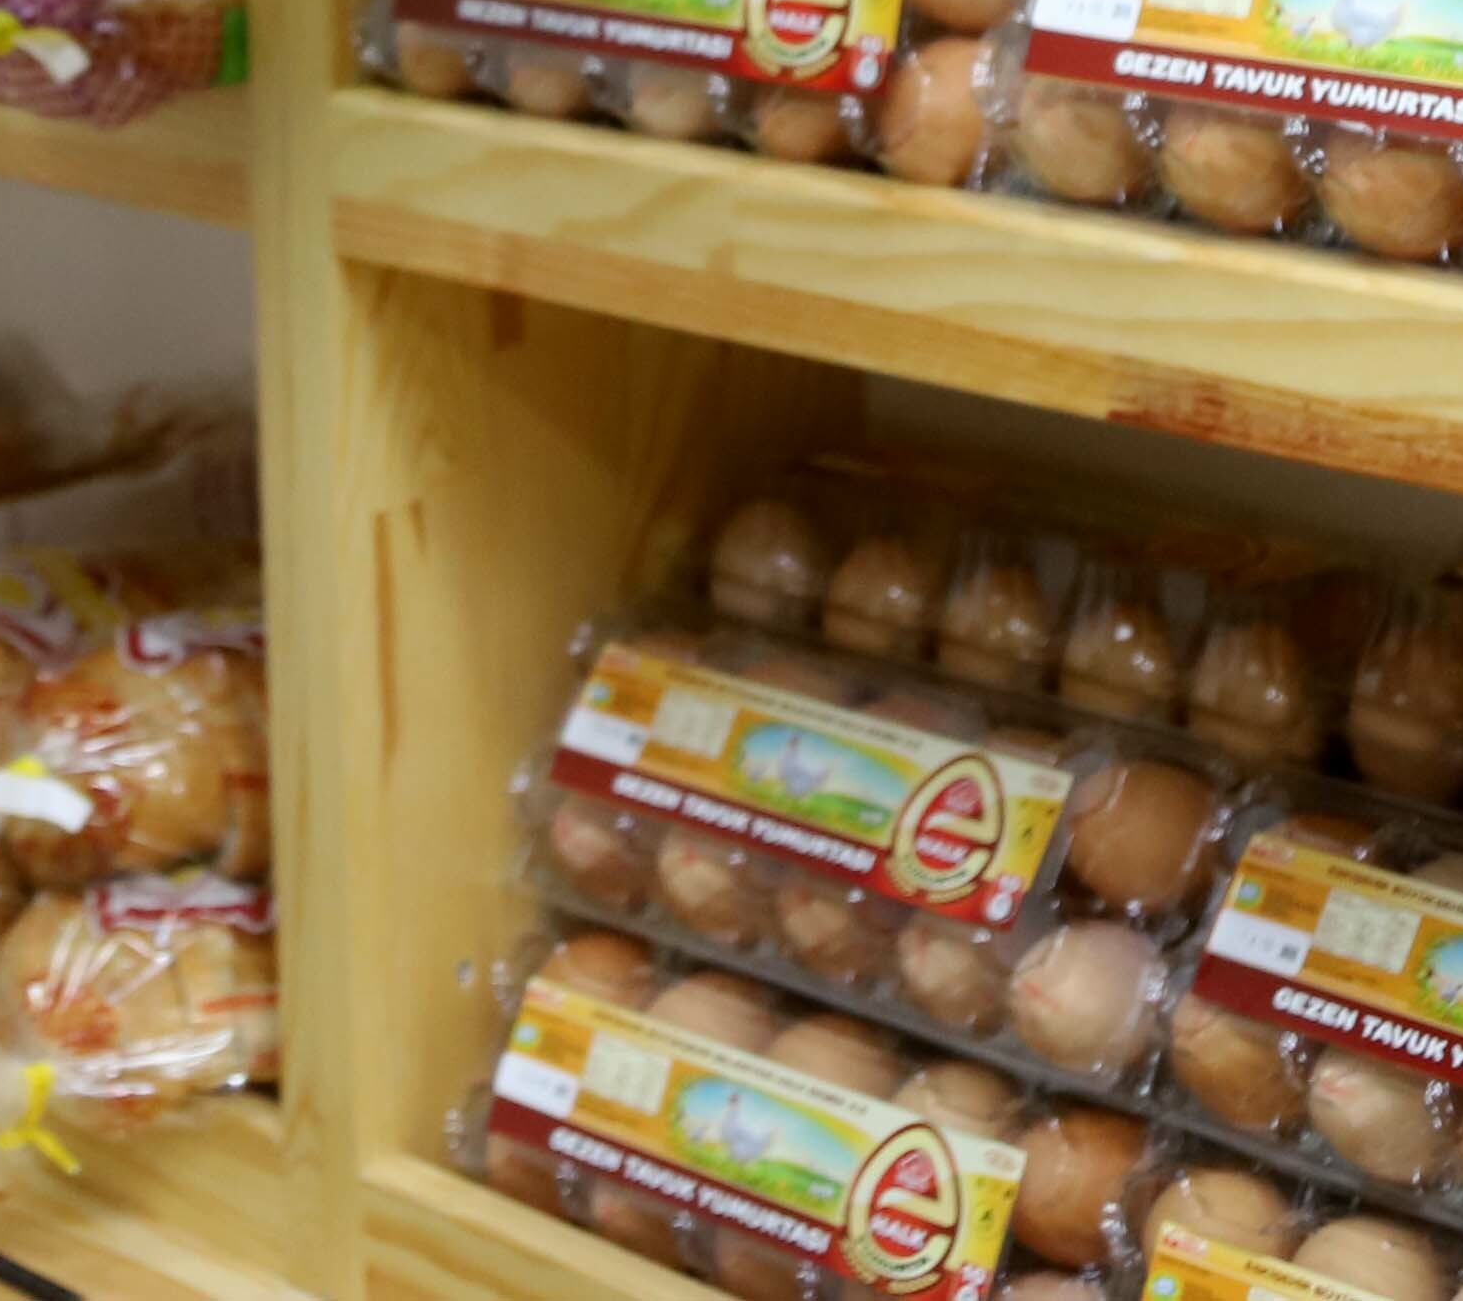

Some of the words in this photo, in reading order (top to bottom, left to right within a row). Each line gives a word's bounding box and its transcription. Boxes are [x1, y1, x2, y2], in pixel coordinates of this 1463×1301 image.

[1113, 50, 1205, 85] GEZEN
[1212, 65, 1305, 98] TAVUK
[1272, 986, 1360, 1033] GEZEN
[1361, 1014, 1448, 1061] TAVUK
